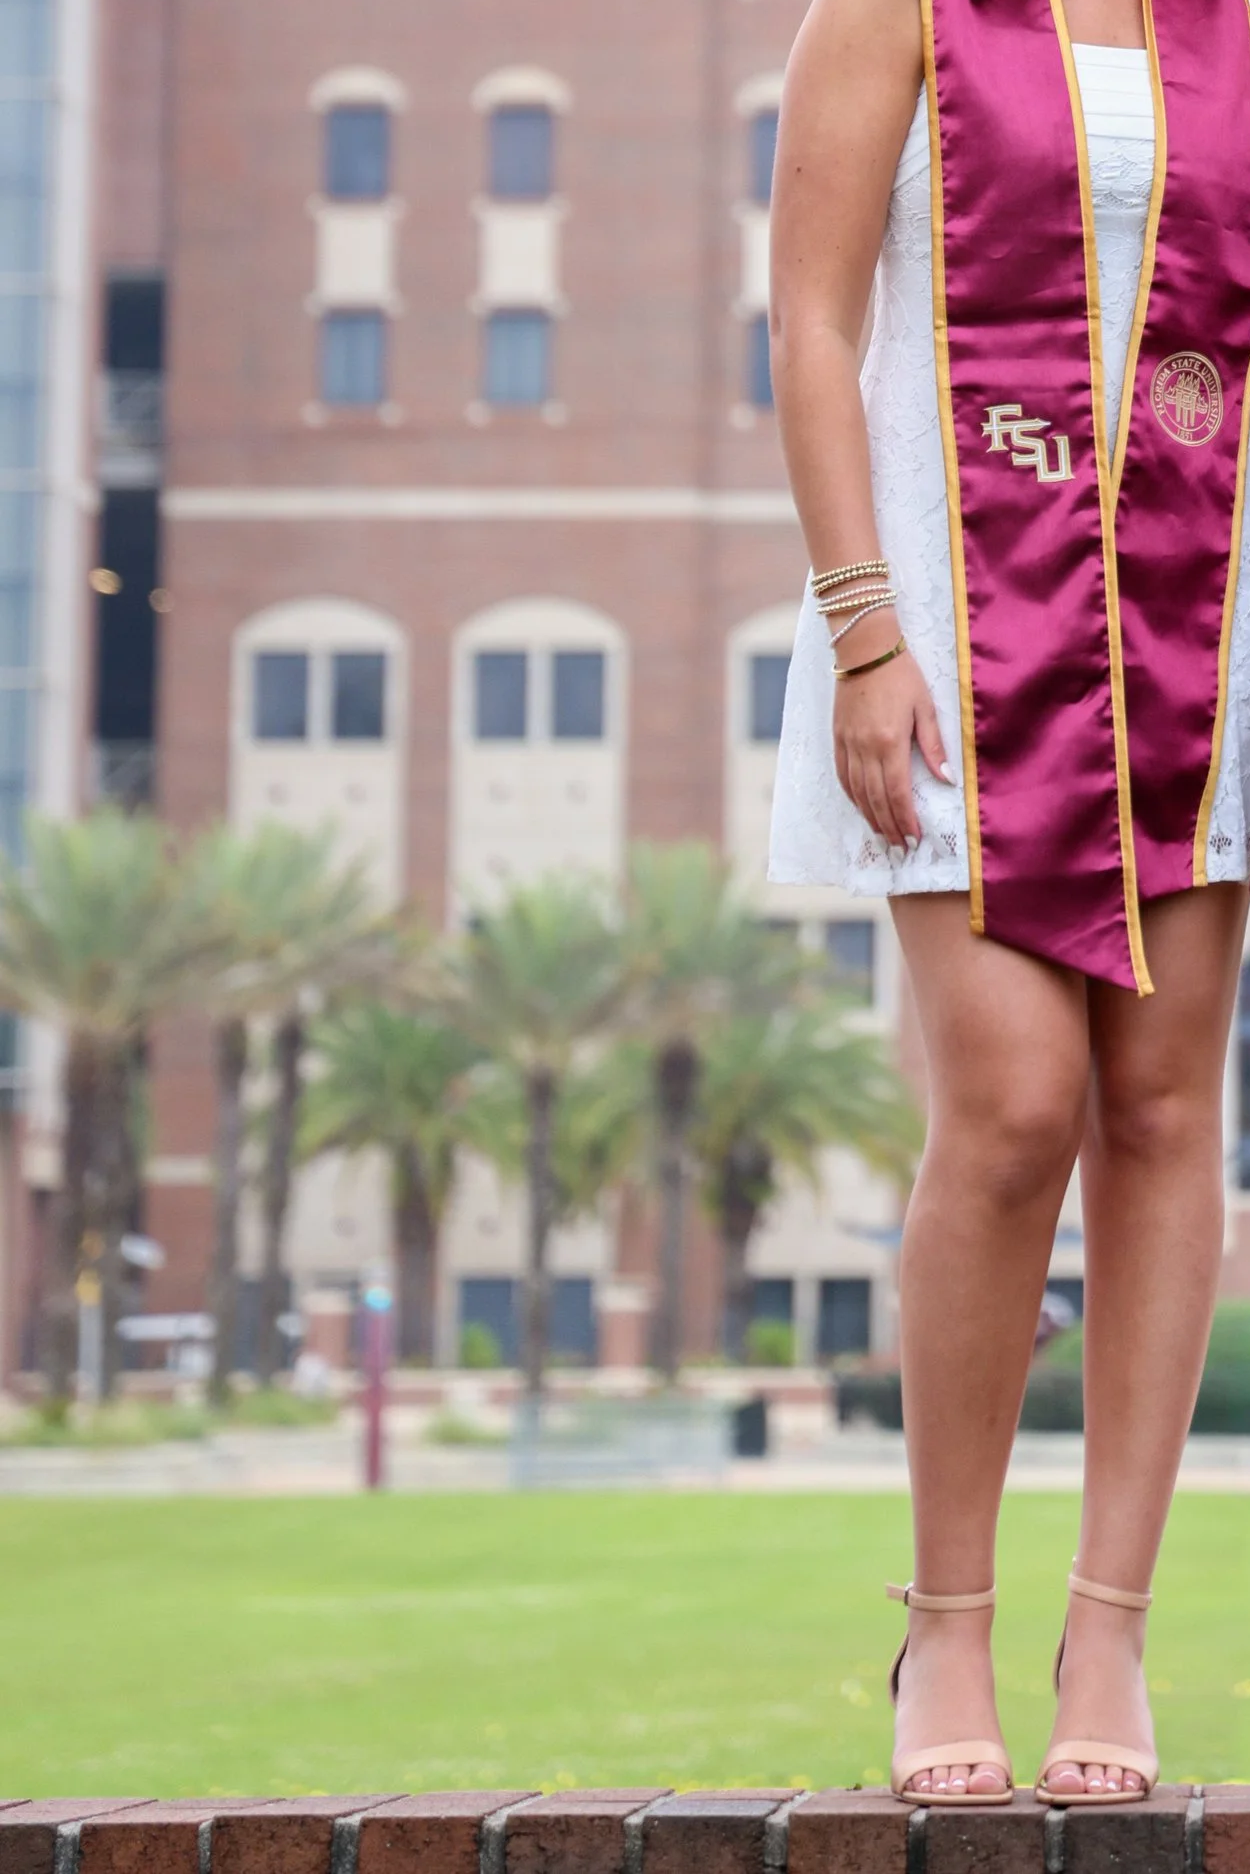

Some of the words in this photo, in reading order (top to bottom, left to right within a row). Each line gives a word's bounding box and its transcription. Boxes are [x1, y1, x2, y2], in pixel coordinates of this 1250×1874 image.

[1171, 357, 1202, 371] STATE
[1200, 366, 1219, 432] UNIVERSITY
[981, 403, 1076, 484] FSU
[1176, 427, 1194, 441] 1851
